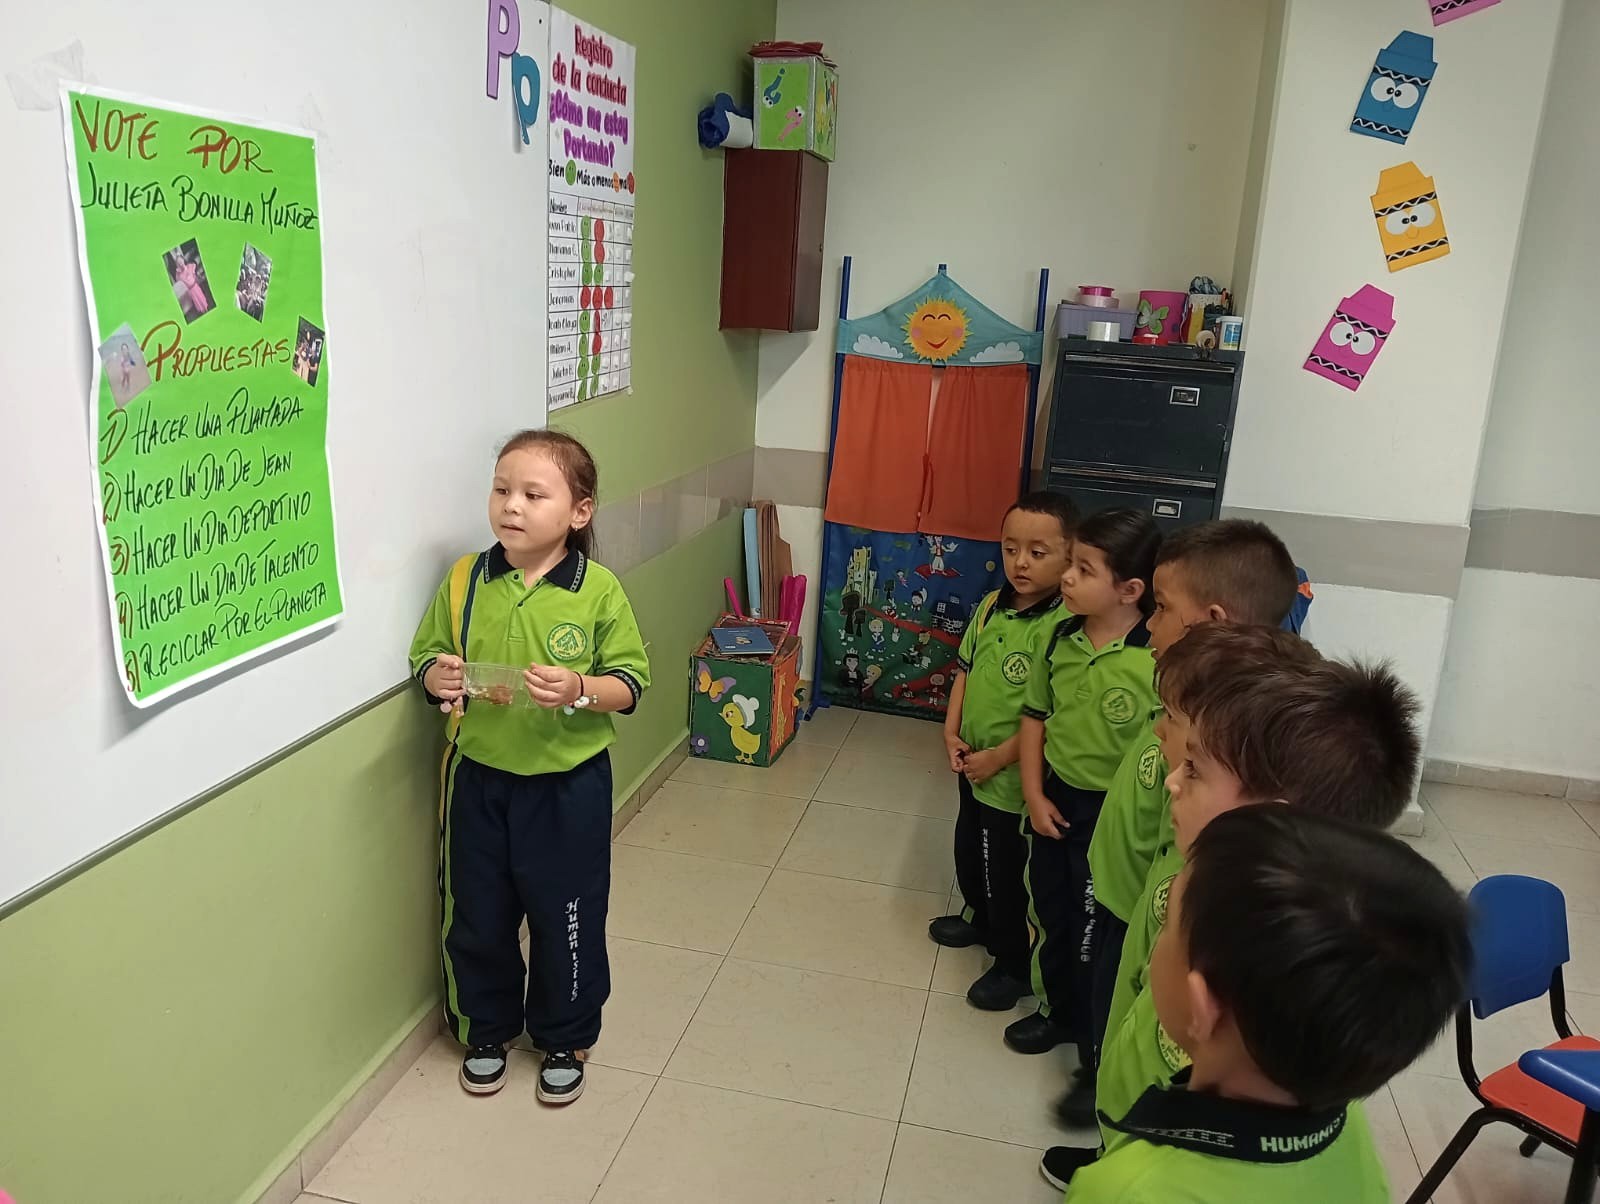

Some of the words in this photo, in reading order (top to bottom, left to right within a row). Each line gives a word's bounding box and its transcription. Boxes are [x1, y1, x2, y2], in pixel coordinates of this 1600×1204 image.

[552, 52, 567, 86] de
[570, 59, 581, 92] la
[586, 72, 627, 107] conducta
[574, 24, 613, 69] Registro
[75, 99, 160, 160] VOTE
[187, 124, 273, 174] POR
[563, 127, 615, 169] Portando?
[587, 105, 601, 132] me
[604, 109, 628, 145] estoy
[81, 161, 168, 212] JULIETA
[171, 174, 254, 224] BONILLA
[261, 187, 318, 234] MUÑOZ
[577, 168, 591, 186] Más
[141, 320, 291, 382] PROPUESTAS
[100, 407, 128, 466] 1)
[132, 400, 188, 455] HACER
[195, 401, 222, 439] UNA
[226, 386, 303, 435] PIJAMADA
[103, 471, 122, 526] 2)
[124, 470, 176, 514] HACER
[179, 460, 196, 498] UN
[198, 453, 225, 500] DIA
[226, 448, 251, 491] DE
[253, 446, 292, 487] JEAN
[111, 536, 130, 576] 3)
[132, 525, 177, 575] HACER
[183, 517, 201, 560] UN
[201, 510, 228, 555] DIA
[227, 491, 311, 543] DEPORTIVO
[115, 591, 133, 640] 4)
[136, 584, 186, 630] HACER
[190, 572, 210, 606] UN
[210, 562, 237, 607] DIA
[235, 552, 257, 596] DE
[257, 539, 319, 585] TALENTO
[125, 650, 141, 693] 5)
[139, 630, 220, 681] RECICLAR
[214, 602, 252, 641] POR
[254, 597, 273, 632] EL
[271, 582, 327, 625] PLANETA
